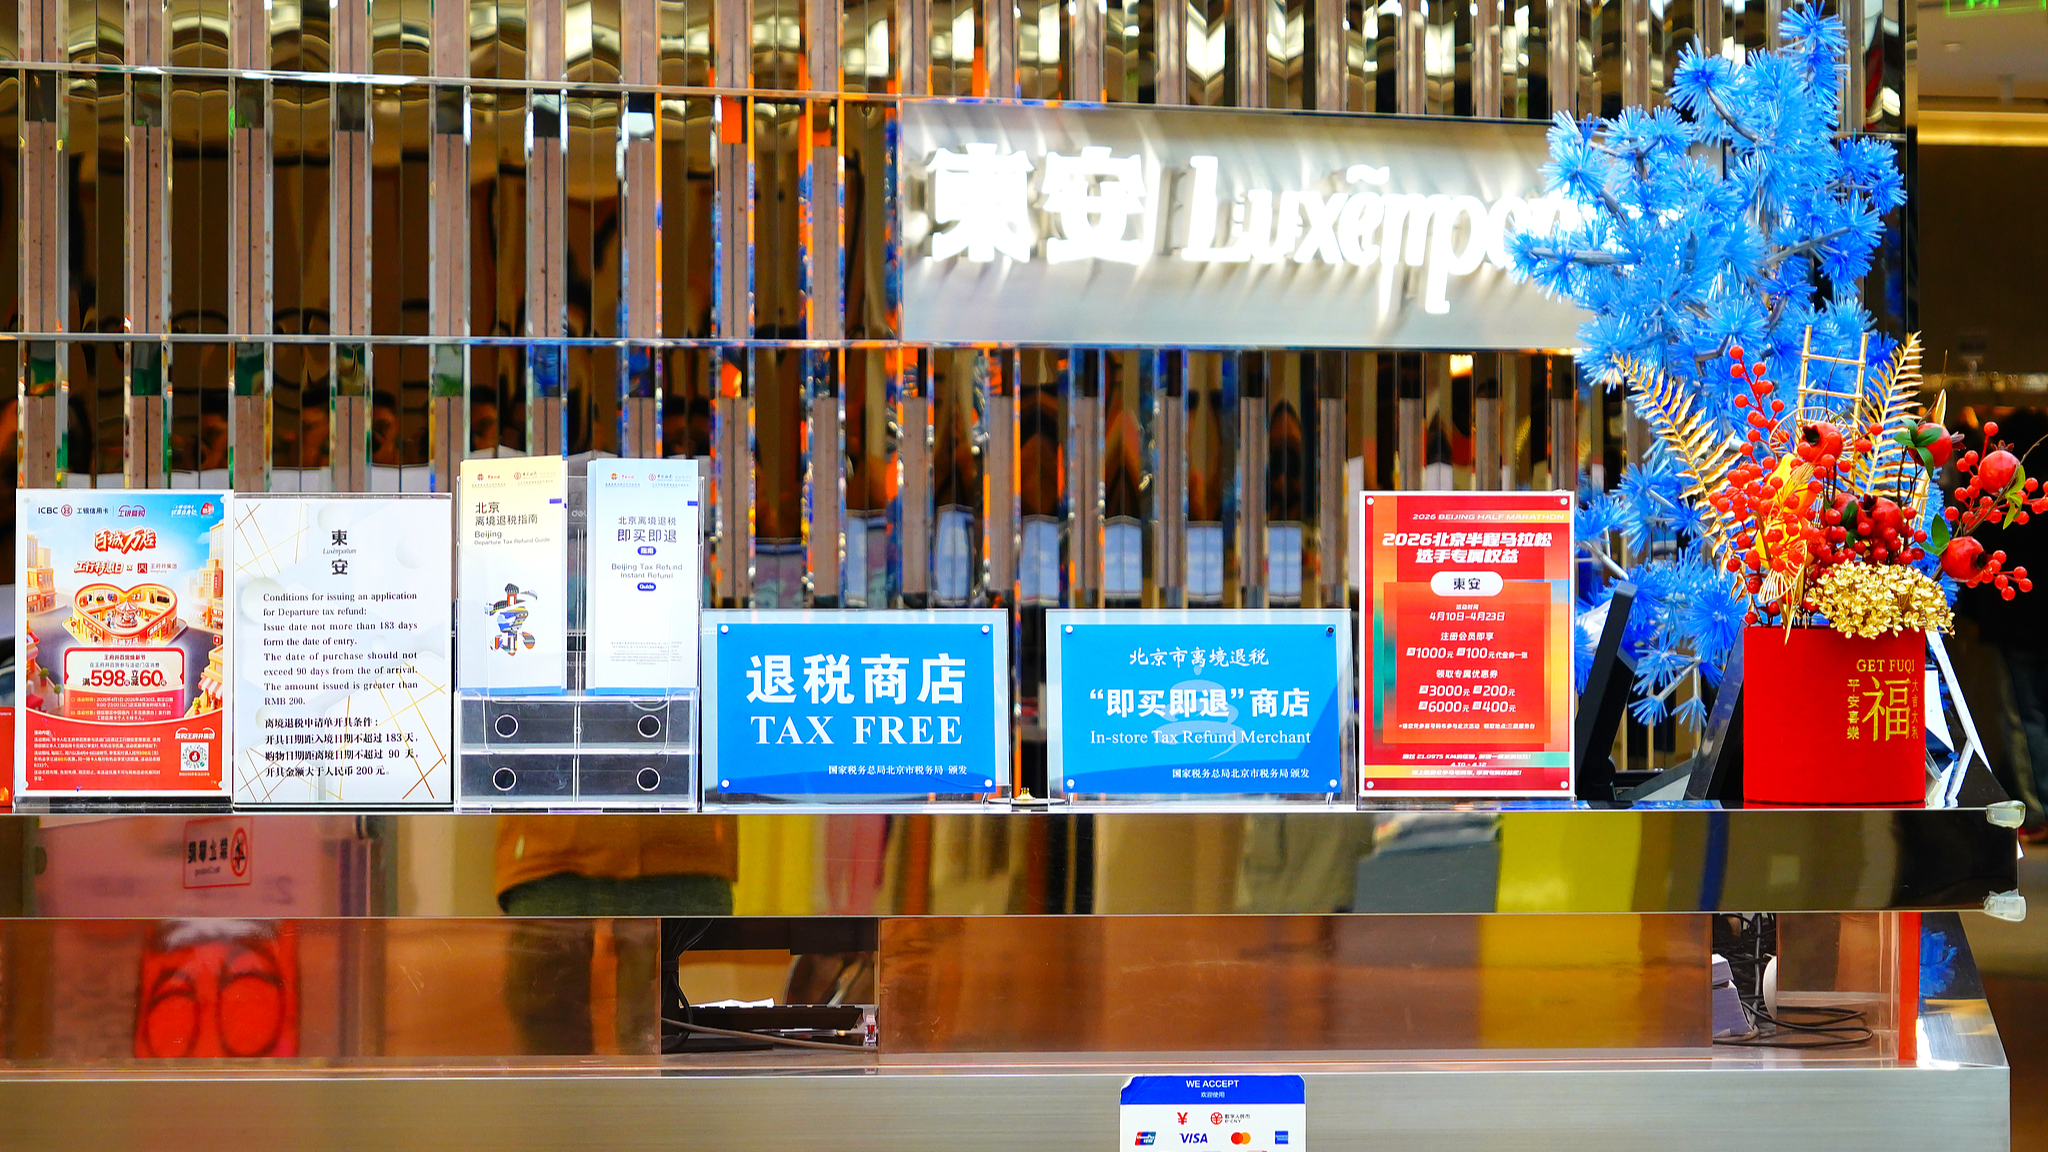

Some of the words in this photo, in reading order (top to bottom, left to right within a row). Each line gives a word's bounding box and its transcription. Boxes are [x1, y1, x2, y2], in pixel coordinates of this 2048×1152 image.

[927, 142, 1150, 265] 東安
[475, 502, 500, 514] 北京
[475, 514, 538, 526] 离境退税指南
[618, 516, 677, 525] 北京离境退税
[94, 526, 156, 554] 百城万店
[332, 530, 347, 546] 東
[475, 530, 502, 539] Beijing
[618, 529, 677, 543] 即买即退
[1382, 532, 1552, 547] 2026北京半程马拉松
[1416, 549, 1519, 564] 选手专属权益
[74, 560, 124, 576] 工行特惠日
[332, 559, 347, 575] 安
[612, 563, 637, 571] Beijing
[1454, 578, 1480, 590] 東安
[263, 593, 308, 601] Conditions
[312, 593, 324, 601] for
[327, 593, 355, 602] issuing
[371, 592, 417, 601] application
[263, 608, 275, 616] for
[278, 608, 319, 618] Departure
[338, 607, 367, 615] refund:
[263, 623, 285, 631] Issue
[289, 623, 307, 631] date
[357, 622, 376, 630] than
[380, 622, 395, 630] 183
[398, 622, 417, 631] days
[263, 638, 283, 646] form
[287, 638, 300, 646] the
[1441, 631, 1494, 641] 注册会员即享
[264, 653, 281, 661] The
[286, 653, 306, 661] date
[323, 652, 364, 662] purchase
[367, 652, 398, 660] should
[1130, 647, 1269, 668] 北京市离境退税
[264, 668, 293, 676] exceed
[310, 667, 329, 677] days
[332, 667, 354, 675] from
[358, 667, 371, 675] the
[375, 666, 385, 674] of
[386, 665, 417, 674] arrival.
[1857, 660, 1885, 672] GET
[1889, 660, 1915, 674] FUQI
[746, 652, 966, 704] 退税商店
[1436, 670, 1498, 679] 领取专属优惠券
[264, 683, 281, 691] The
[323, 682, 349, 690] issued
[364, 682, 395, 691] greater
[399, 681, 418, 689] than
[289, 697, 305, 705] 200.
[1847, 679, 1860, 740] 平安喜樂
[1862, 676, 1911, 741] 福
[750, 716, 834, 744] TAX
[852, 716, 962, 744] FREE
[265, 733, 382, 745] 开具日期距入境日期不超过
[386, 733, 402, 742] 183
[1090, 731, 1148, 744] In-store
[1152, 731, 1178, 744] Tax
[1183, 730, 1237, 744] Refund
[1241, 730, 1311, 744] Merchant
[265, 749, 383, 761] 购物日期距离境日期不超过
[389, 749, 399, 758] 90
[266, 766, 353, 777] 开具金额大于人民币
[357, 766, 373, 775] 200
[828, 765, 943, 775] 国家税务总局北京市税务局
[948, 765, 967, 775] 颁发
[1172, 768, 1288, 778] 国家税务总局北京市税务局
[1290, 768, 1310, 778] 颁发
[1203, 1080, 1239, 1088] ACCEPT
[1179, 1133, 1208, 1143] VISA
